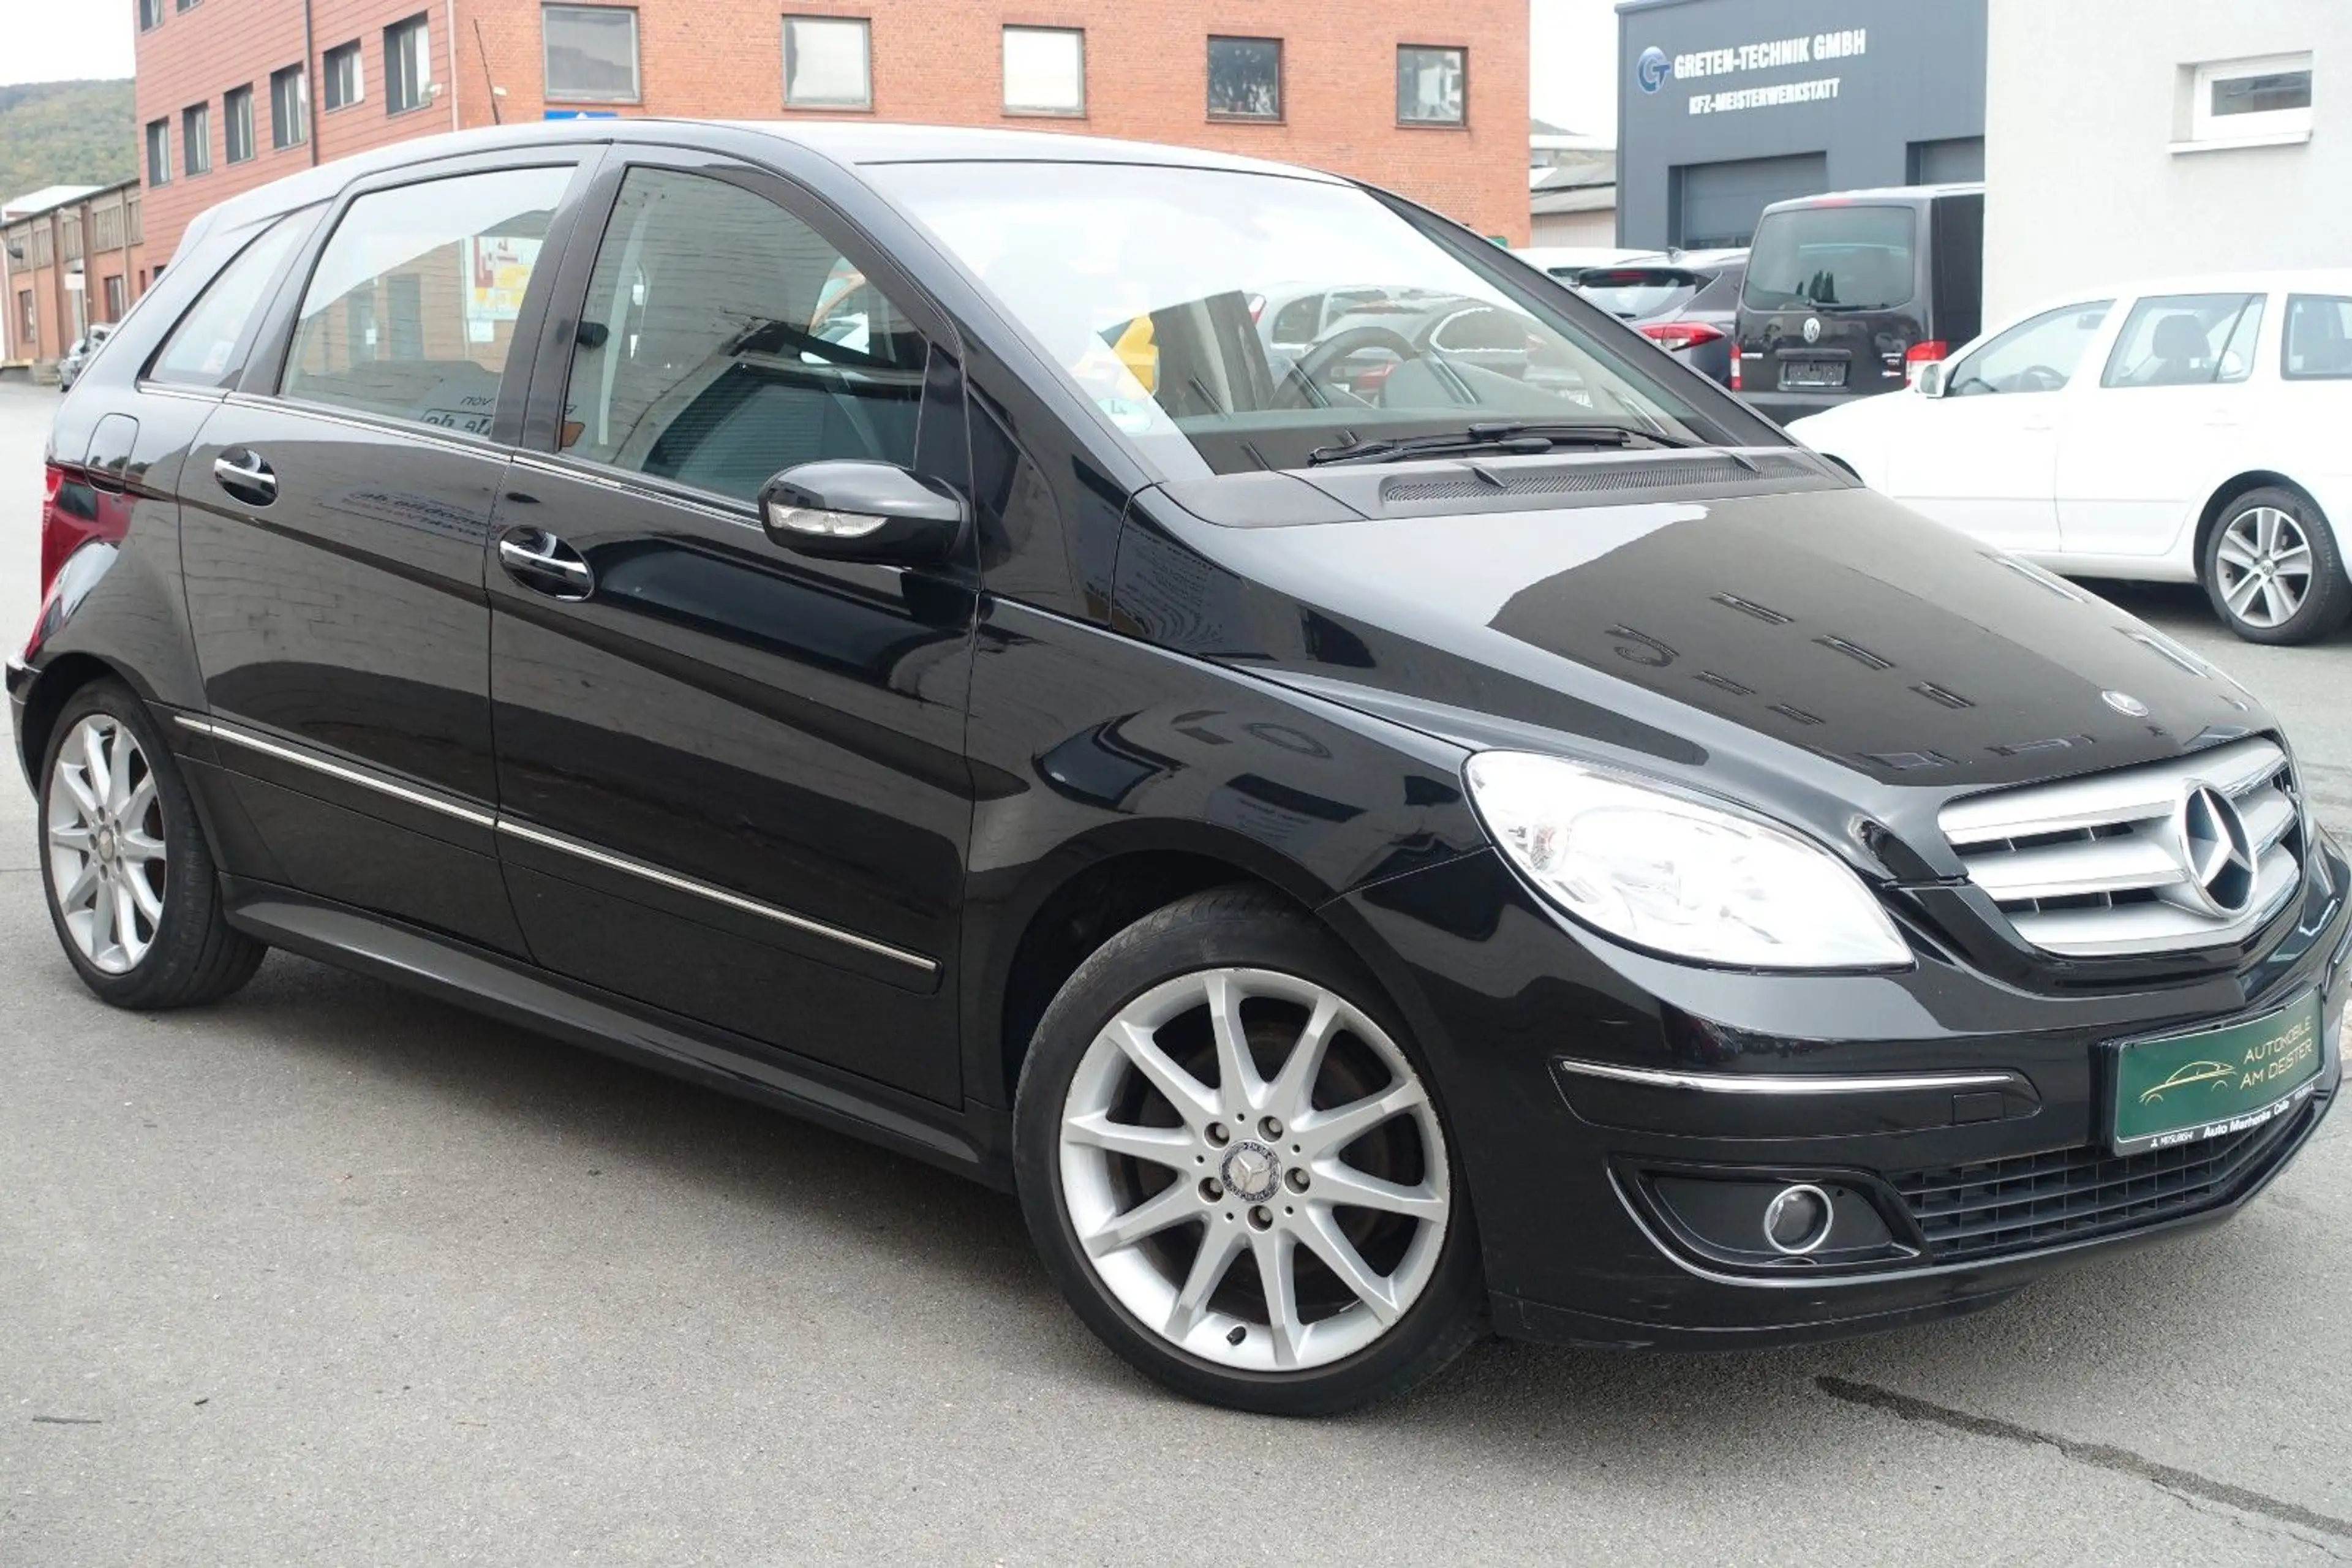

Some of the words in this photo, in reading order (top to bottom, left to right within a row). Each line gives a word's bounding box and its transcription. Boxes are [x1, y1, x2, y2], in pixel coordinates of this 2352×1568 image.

[1674, 37, 1810, 79] GRETEN-TECHNIK
[1813, 28, 1866, 61] GMBH
[1689, 77, 1840, 115] KFZ-MEISTERWERKSTATT
[2240, 1069, 2264, 1090] AM
[2203, 1126, 2228, 1139] Auto
